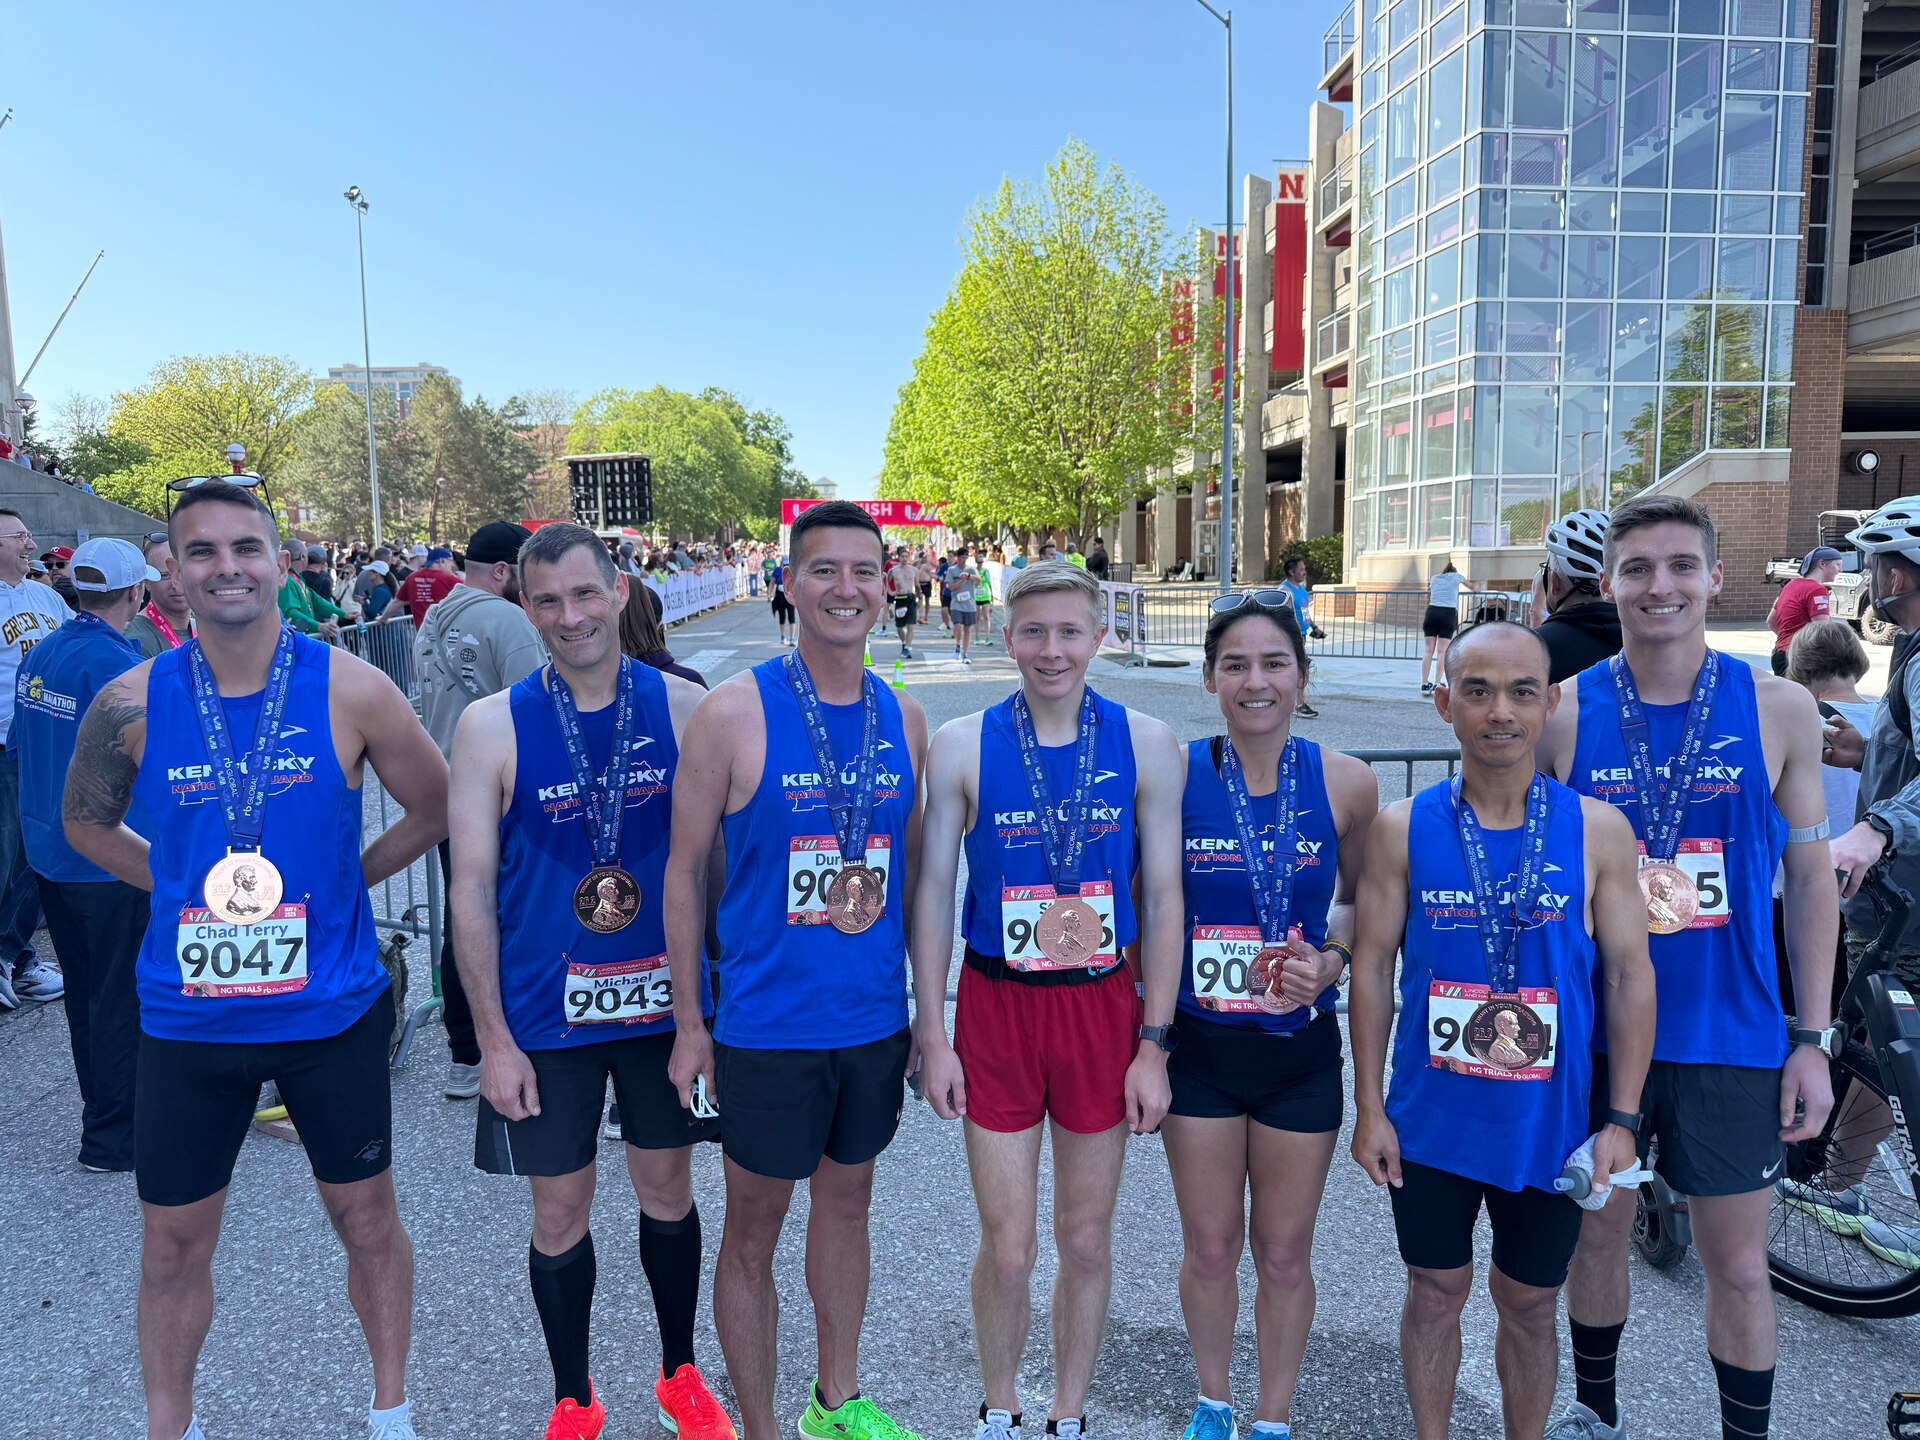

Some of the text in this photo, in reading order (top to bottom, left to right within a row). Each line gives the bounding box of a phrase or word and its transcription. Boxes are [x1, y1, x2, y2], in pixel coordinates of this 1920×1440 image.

[1279, 174, 1304, 199] N
[30, 687, 42, 699] 66
[195, 924, 288, 939] Chad Terry
[181, 937, 304, 979] 9047
[594, 973, 652, 989] Michael
[220, 986, 232, 994] NG
[234, 985, 262, 994] TRIALS
[569, 979, 674, 1018] 9043
[1469, 1066, 1482, 1074] NG
[1483, 1067, 1512, 1077] TRIALS
